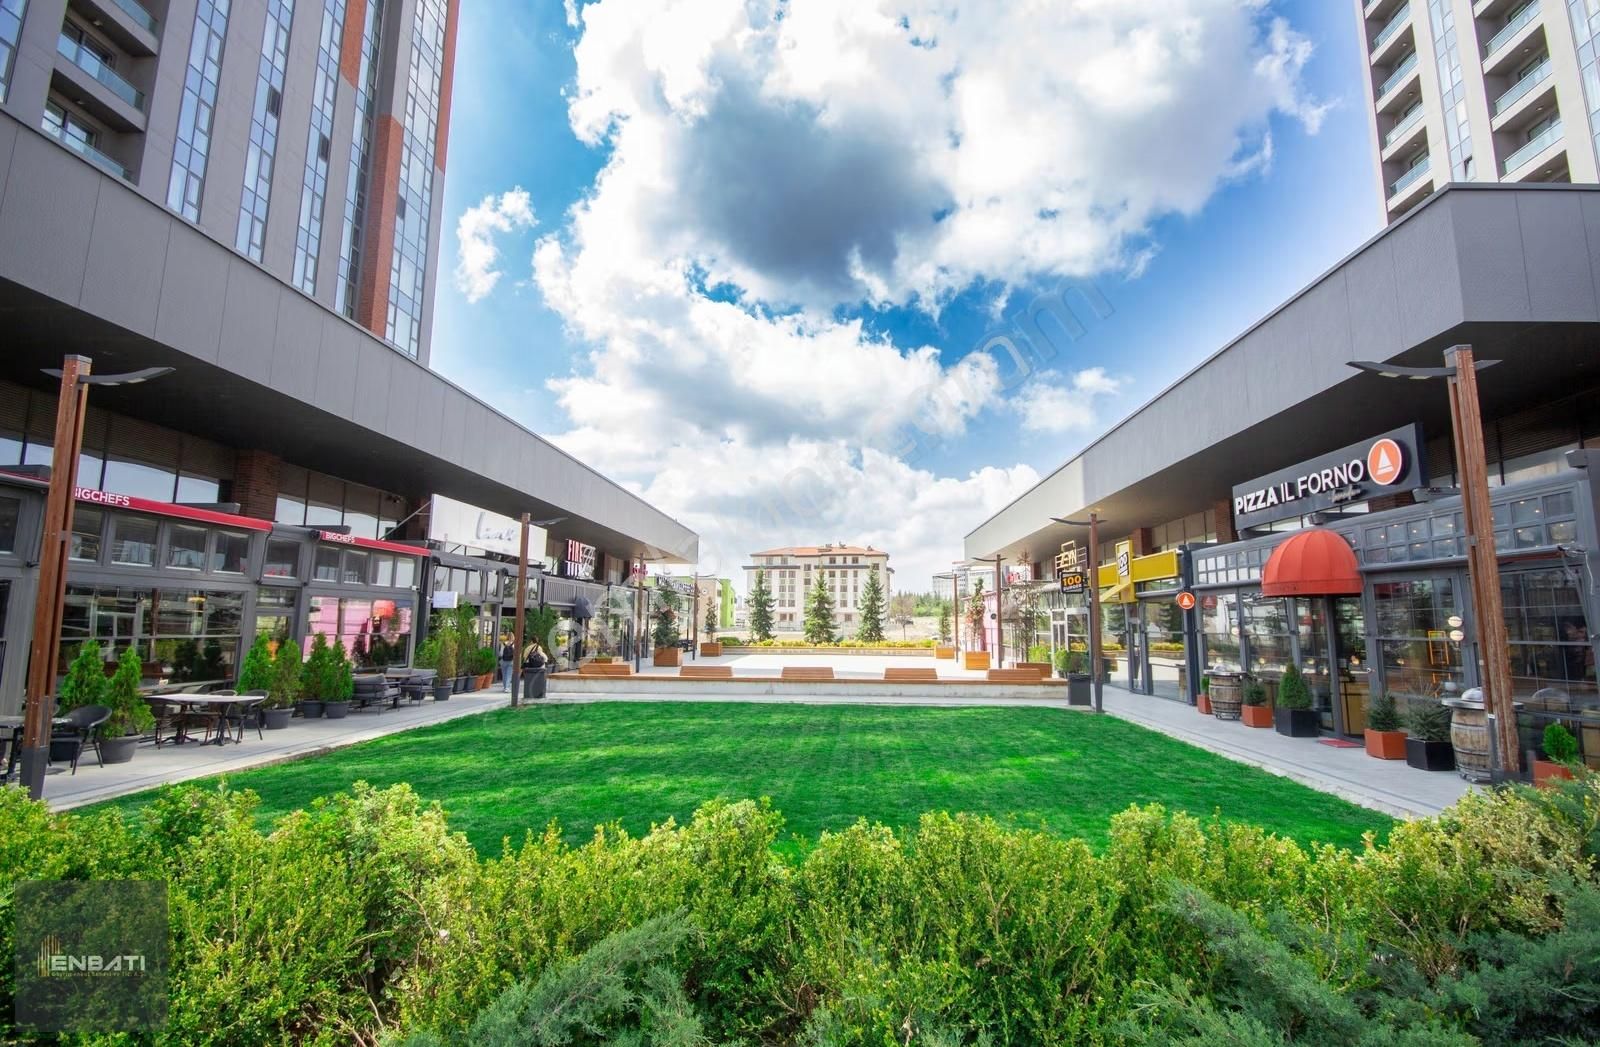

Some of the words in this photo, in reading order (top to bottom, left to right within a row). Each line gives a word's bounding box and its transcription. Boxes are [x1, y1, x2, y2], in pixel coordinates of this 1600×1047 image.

[1235, 487, 1278, 514] PIZZA
[1281, 482, 1295, 503] IL
[1297, 460, 1364, 499] FORNO
[1062, 575, 1081, 586] 100
